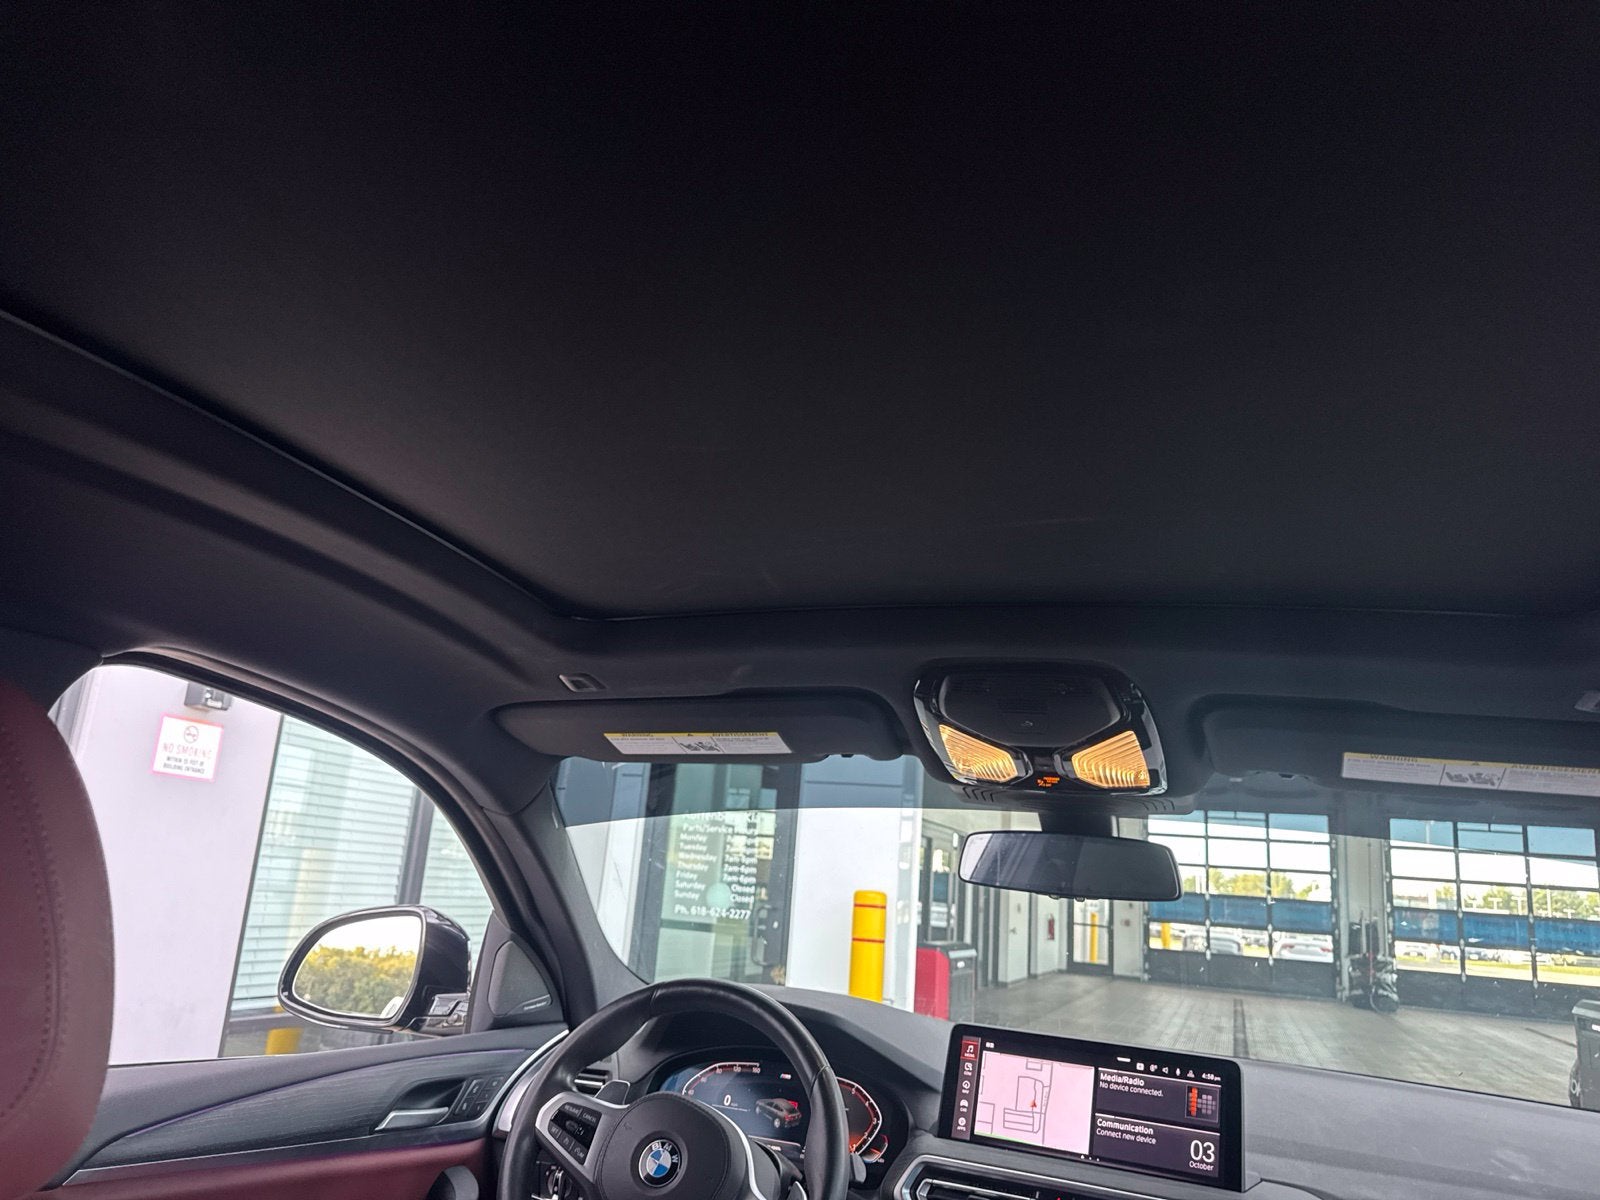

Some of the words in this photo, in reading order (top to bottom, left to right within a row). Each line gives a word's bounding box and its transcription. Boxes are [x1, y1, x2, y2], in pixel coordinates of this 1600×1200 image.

[163, 742, 174, 753] NO
[176, 744, 212, 759] SMOKING
[680, 833, 708, 843] Monday
[679, 842, 708, 853] Tuesday
[678, 852, 718, 862] Wednesday
[677, 861, 710, 872] Thursday
[676, 870, 698, 880] Friday
[675, 880, 706, 891] Saturday
[730, 884, 756, 894] Closed
[674, 890, 700, 900] Sunday
[730, 894, 754, 903] Closed
[674, 904, 689, 914] Ph.
[1100, 1072, 1145, 1086] Media/Radio
[1109, 1082, 1129, 1092] device
[1130, 1086, 1164, 1097] connected.
[724, 1094, 731, 1106] 0
[1096, 1118, 1154, 1135] Communication
[1096, 1128, 1122, 1138] Connect
[1122, 1133, 1135, 1141] new
[1136, 1134, 1157, 1144] device
[651, 1142, 679, 1163] BMW
[1190, 1140, 1215, 1162] 03
[1189, 1160, 1214, 1171] October
